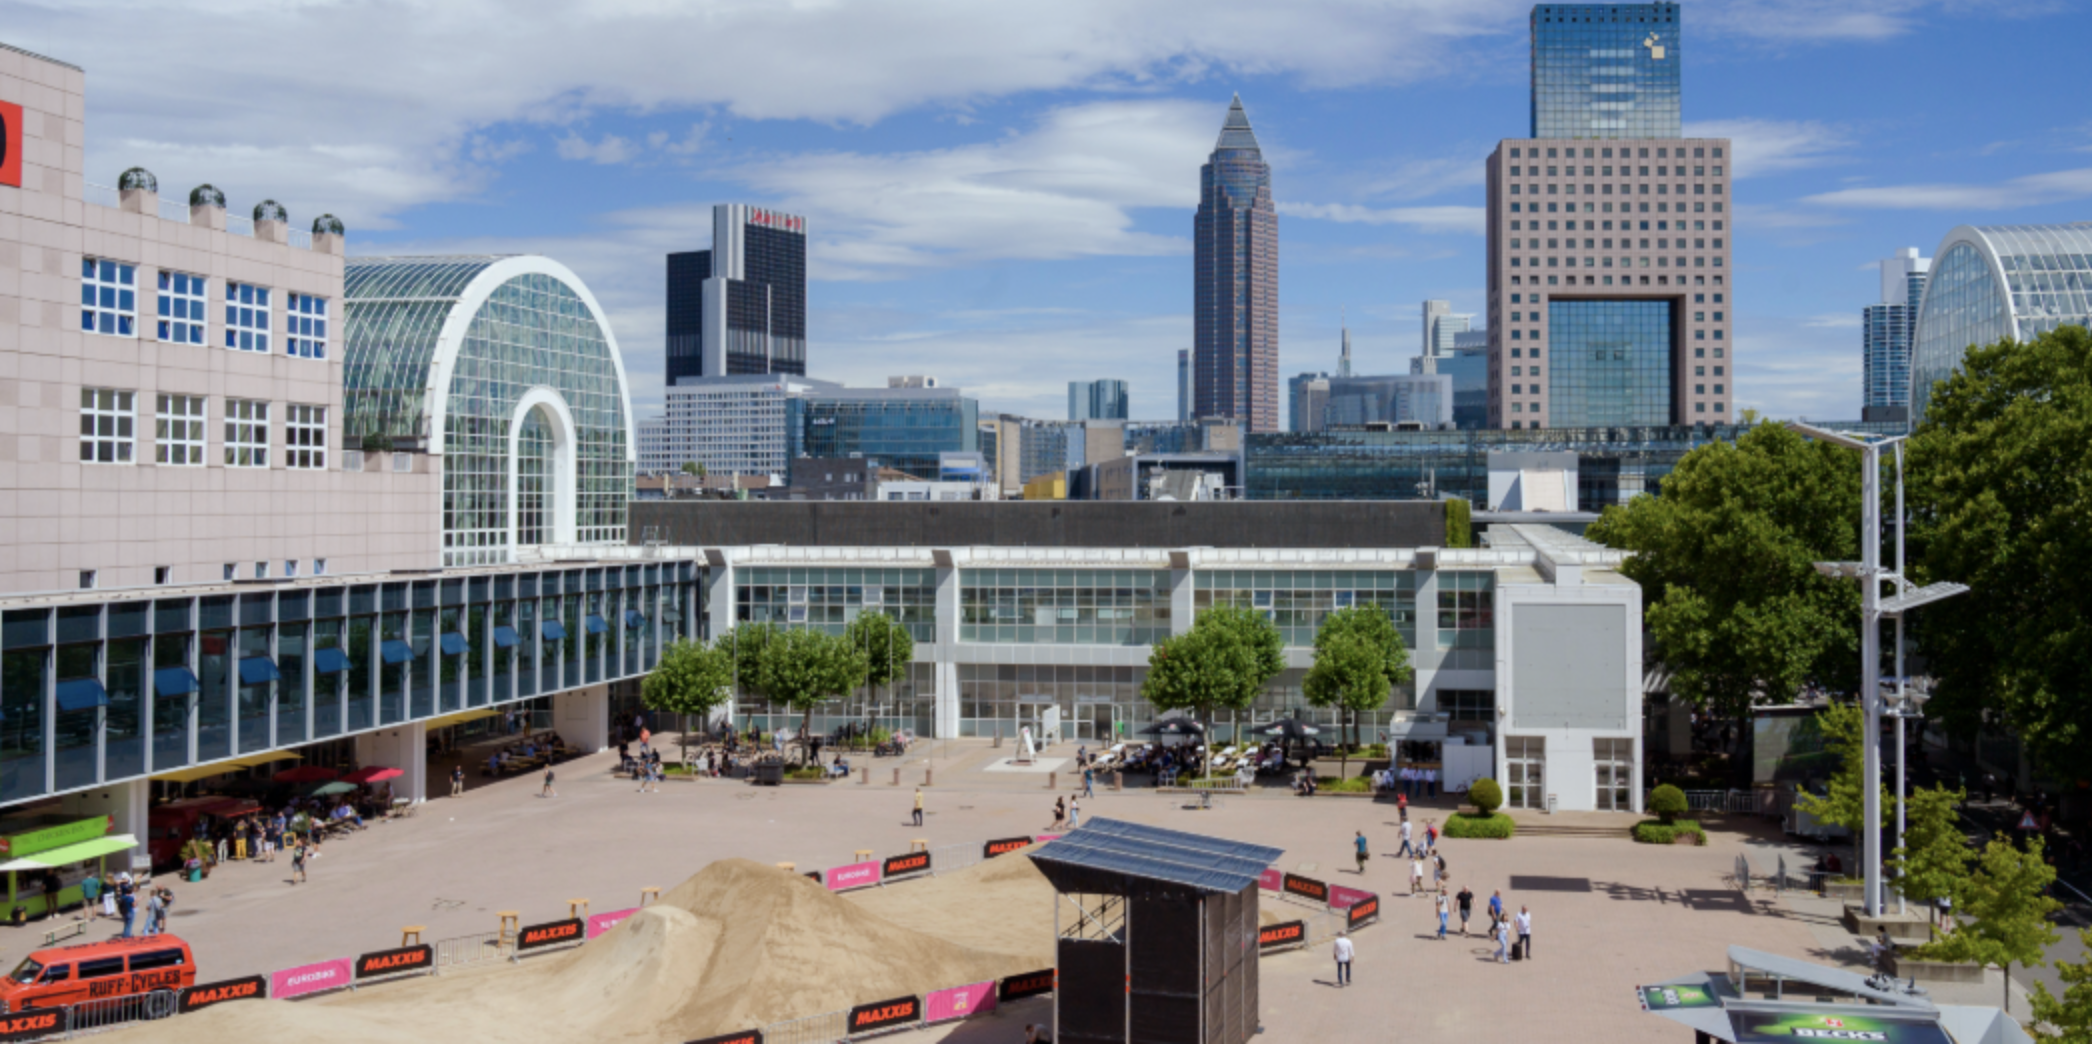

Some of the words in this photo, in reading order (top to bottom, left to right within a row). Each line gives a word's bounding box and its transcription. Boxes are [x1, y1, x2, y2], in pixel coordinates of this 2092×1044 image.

[888, 855, 927, 872] MAXXIS
[525, 923, 577, 943] MAXXIS
[363, 949, 426, 971] MAXXIS
[287, 968, 337, 987] EUROBIKE
[187, 981, 258, 1006] MAXXIS
[0, 1013, 57, 1035] AXXIS
[855, 1002, 913, 1026] MAXXIS
